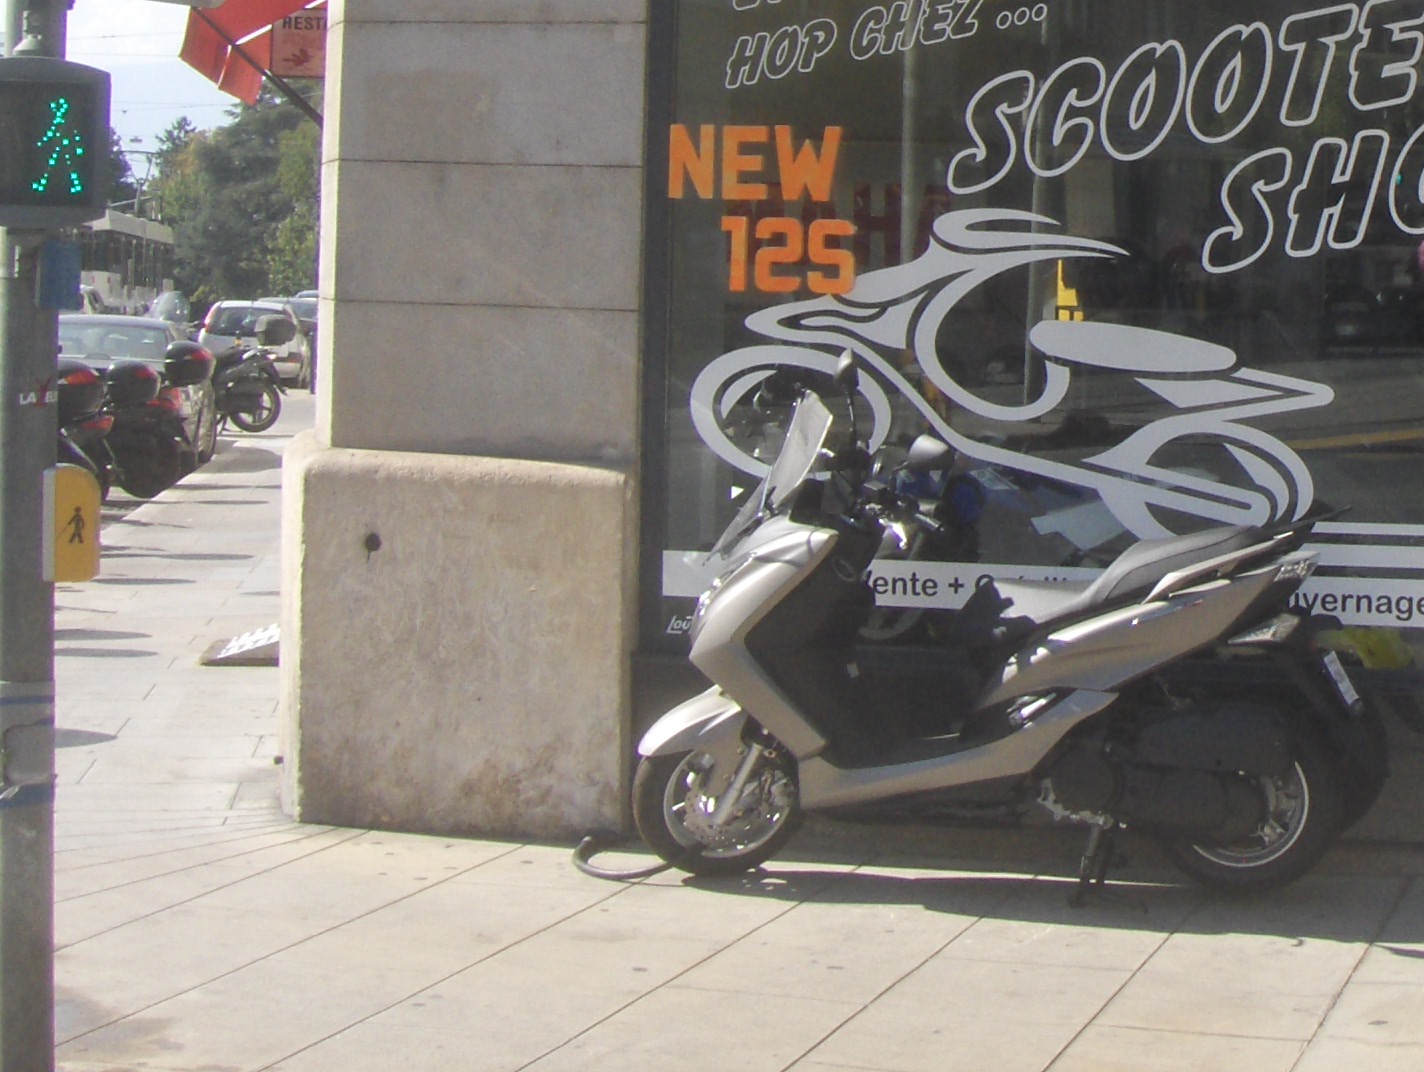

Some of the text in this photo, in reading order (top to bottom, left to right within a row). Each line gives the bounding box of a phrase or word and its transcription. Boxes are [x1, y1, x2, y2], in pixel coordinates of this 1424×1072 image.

[726, 18, 837, 89] HOP
[668, 124, 843, 202] NEW
[720, 216, 857, 296] 125
